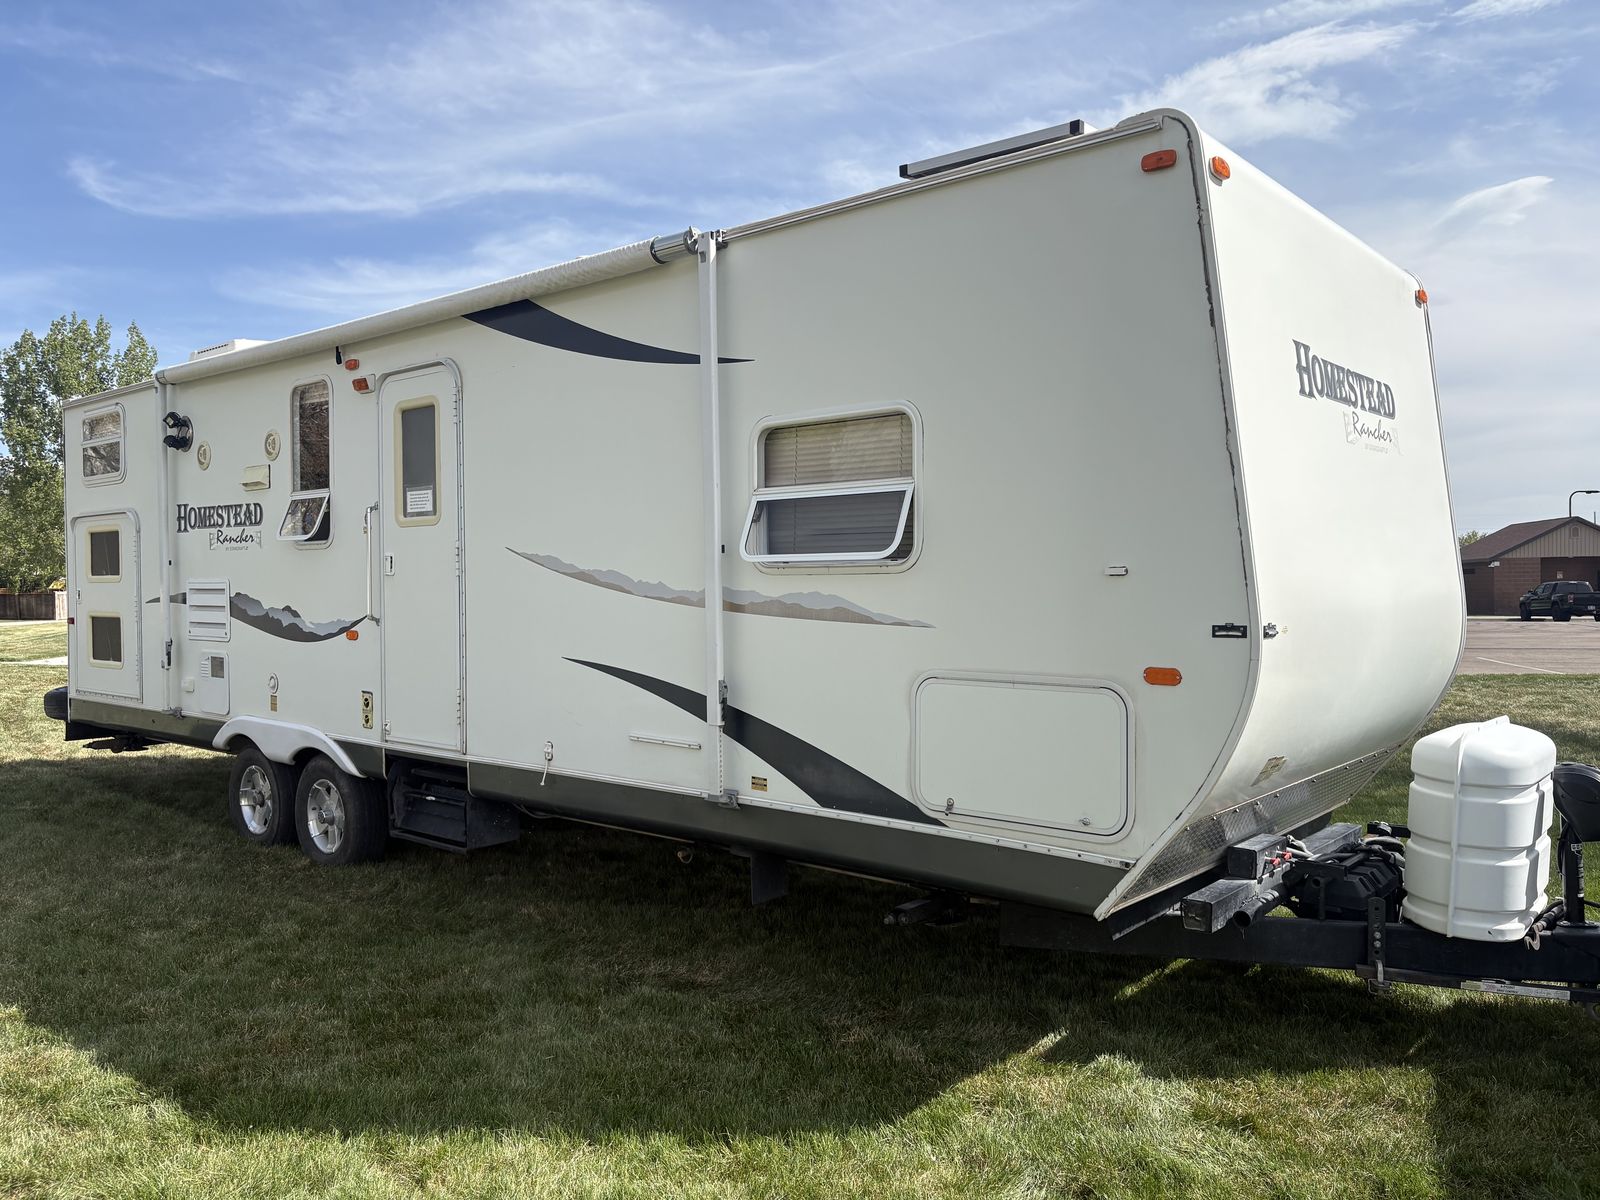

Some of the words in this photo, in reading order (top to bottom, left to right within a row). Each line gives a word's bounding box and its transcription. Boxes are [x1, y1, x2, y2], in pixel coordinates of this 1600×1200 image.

[1292, 339, 1396, 420] HOMESTEAD
[1351, 411, 1393, 443] Rancher
[176, 503, 263, 533] HOMESTEAD
[216, 528, 255, 545] Rancher
